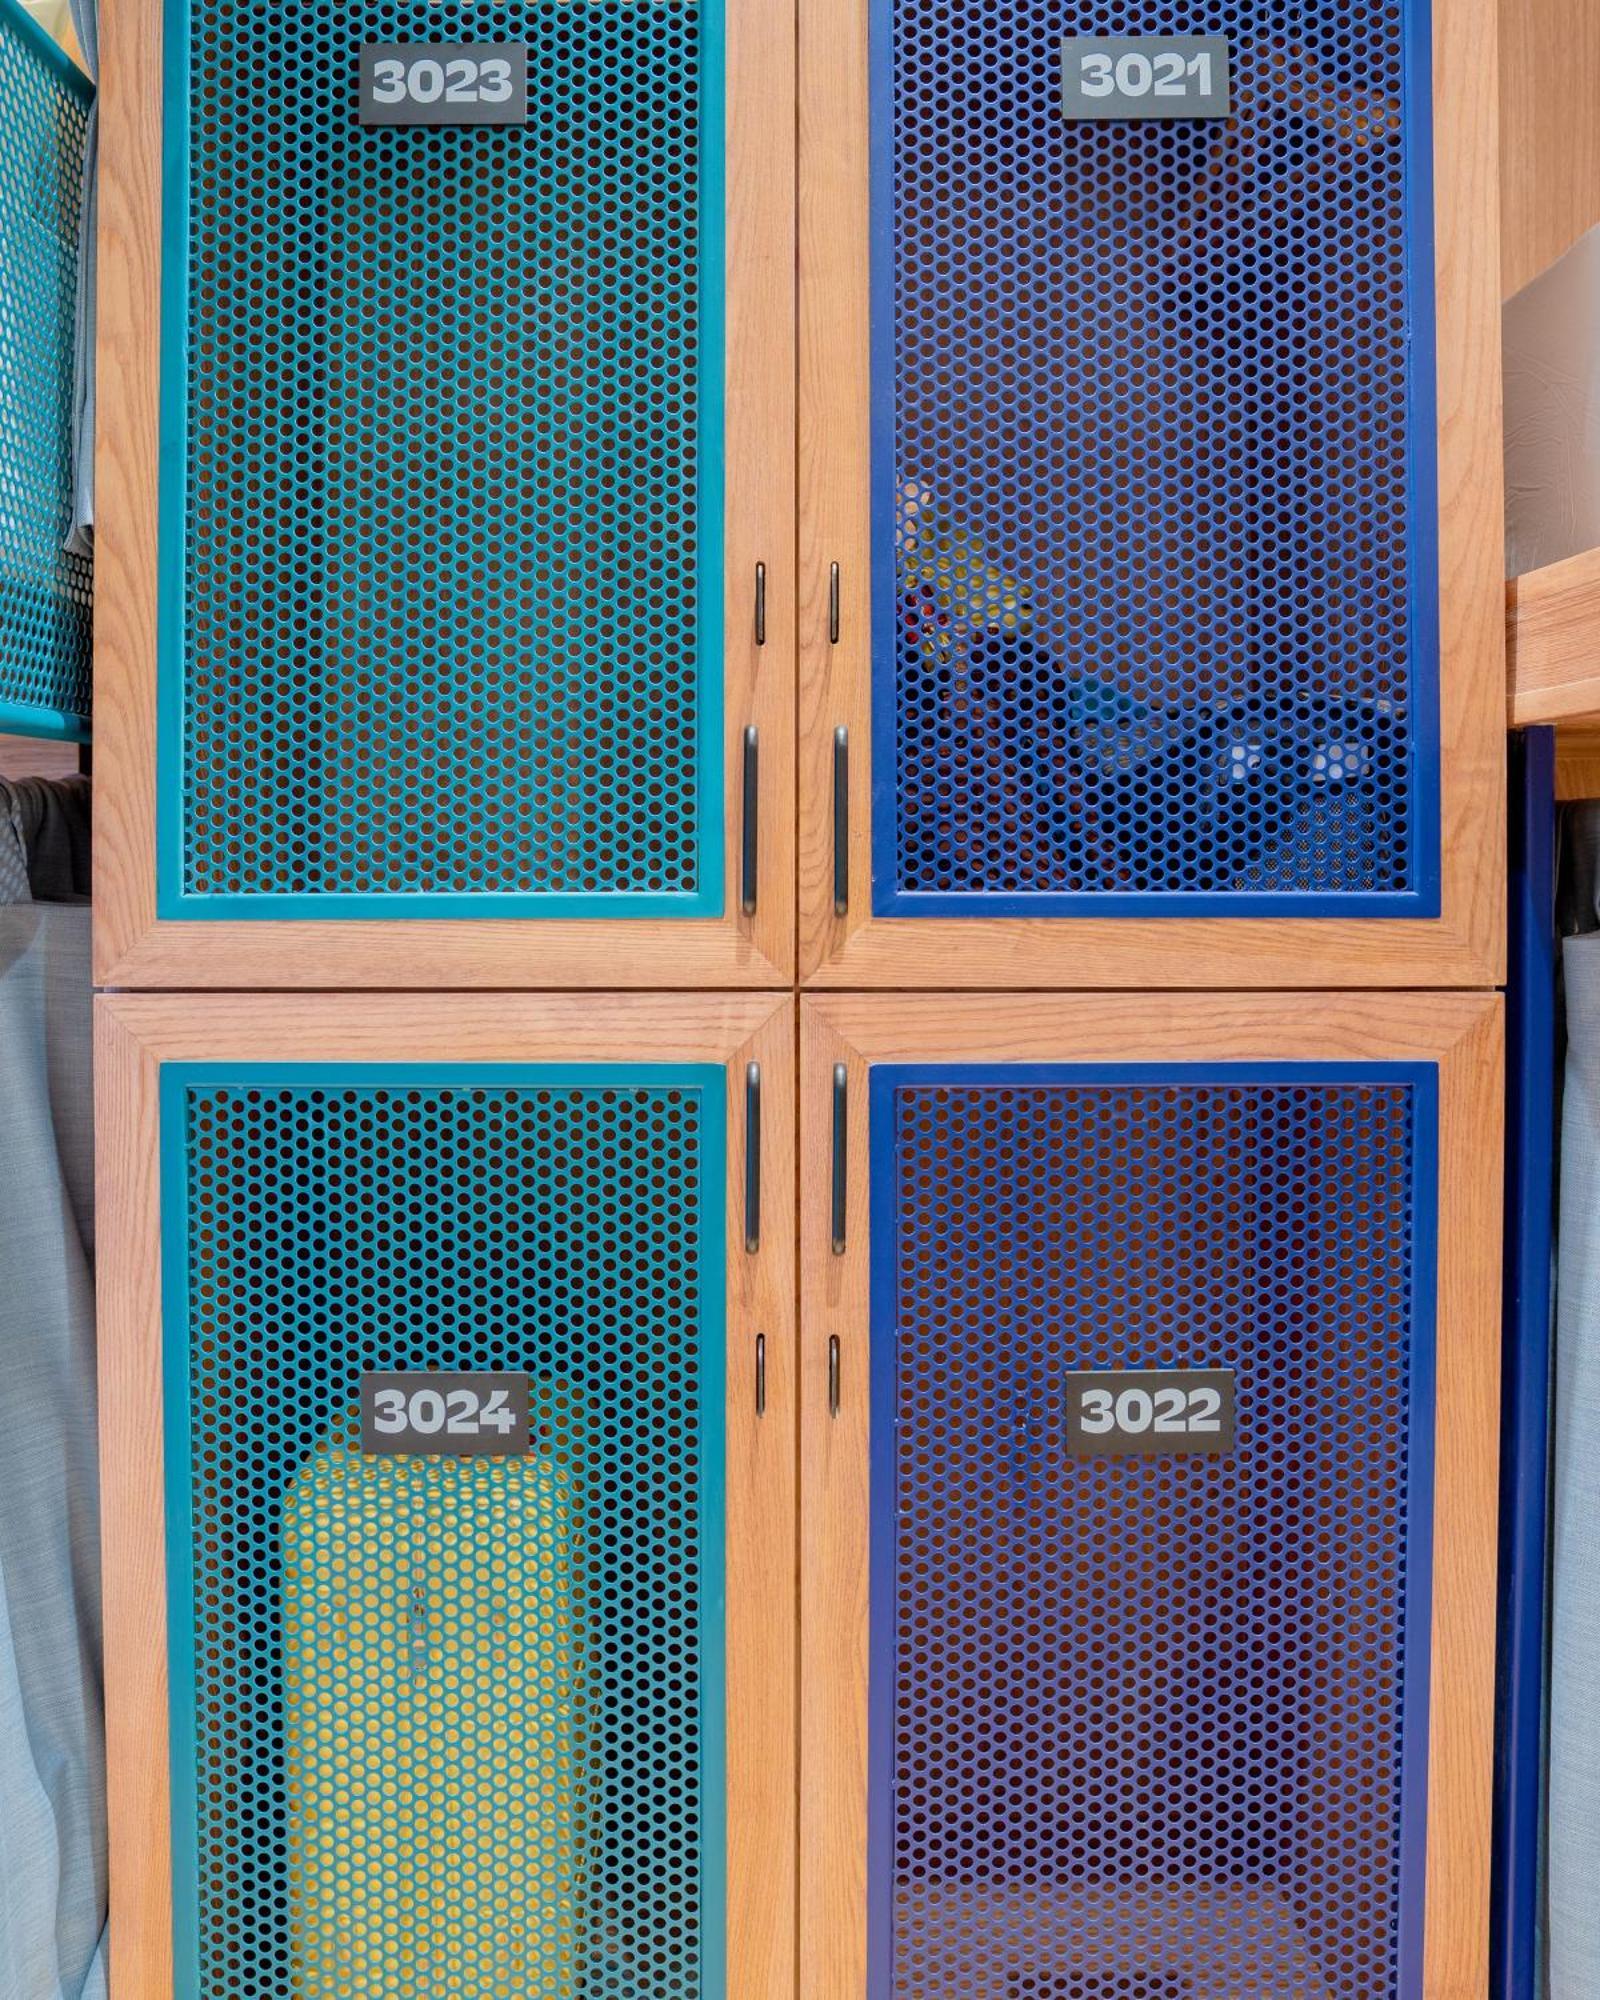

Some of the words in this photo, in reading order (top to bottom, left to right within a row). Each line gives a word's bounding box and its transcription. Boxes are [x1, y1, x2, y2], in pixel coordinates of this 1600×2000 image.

[372, 60, 513, 103] 3023
[1080, 53, 1212, 97] 3021
[374, 1390, 516, 1434] 3024
[1081, 1388, 1221, 1434] 3022
